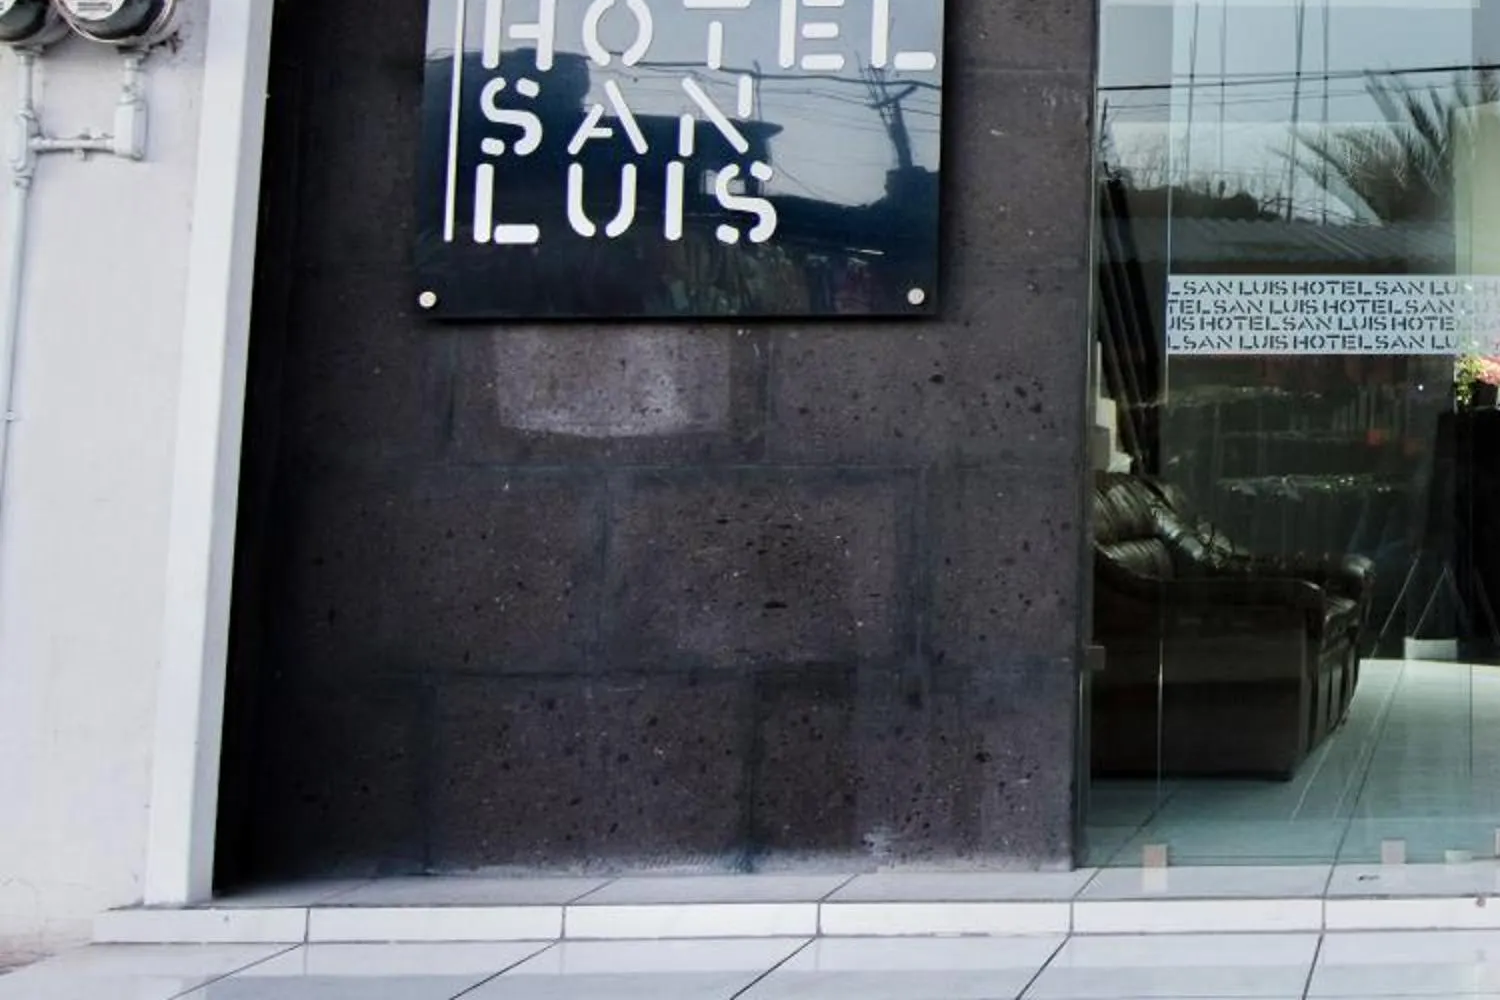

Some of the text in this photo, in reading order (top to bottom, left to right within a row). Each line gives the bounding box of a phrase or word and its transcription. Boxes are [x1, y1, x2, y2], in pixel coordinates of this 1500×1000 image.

[480, 74, 753, 157] SAN
[473, 160, 777, 245] LUIS
[1184, 281, 1233, 295] SAN
[1239, 281, 1288, 295] LUIS
[1293, 281, 1372, 295] HOTEL
[1374, 281, 1425, 295] SAN
[1214, 300, 1264, 314] SAN
[1270, 300, 1319, 314] LUIS
[1324, 300, 1402, 314] HOTEL
[1405, 300, 1455, 314] SAN
[1200, 317, 1279, 331] HOTEL
[1283, 317, 1333, 331] SAN
[1339, 317, 1387, 331] LUIS
[1184, 335, 1233, 350] SAN
[1239, 335, 1288, 350] LUIS
[1293, 335, 1373, 350] HOTEL
[1375, 335, 1425, 350] SAN
